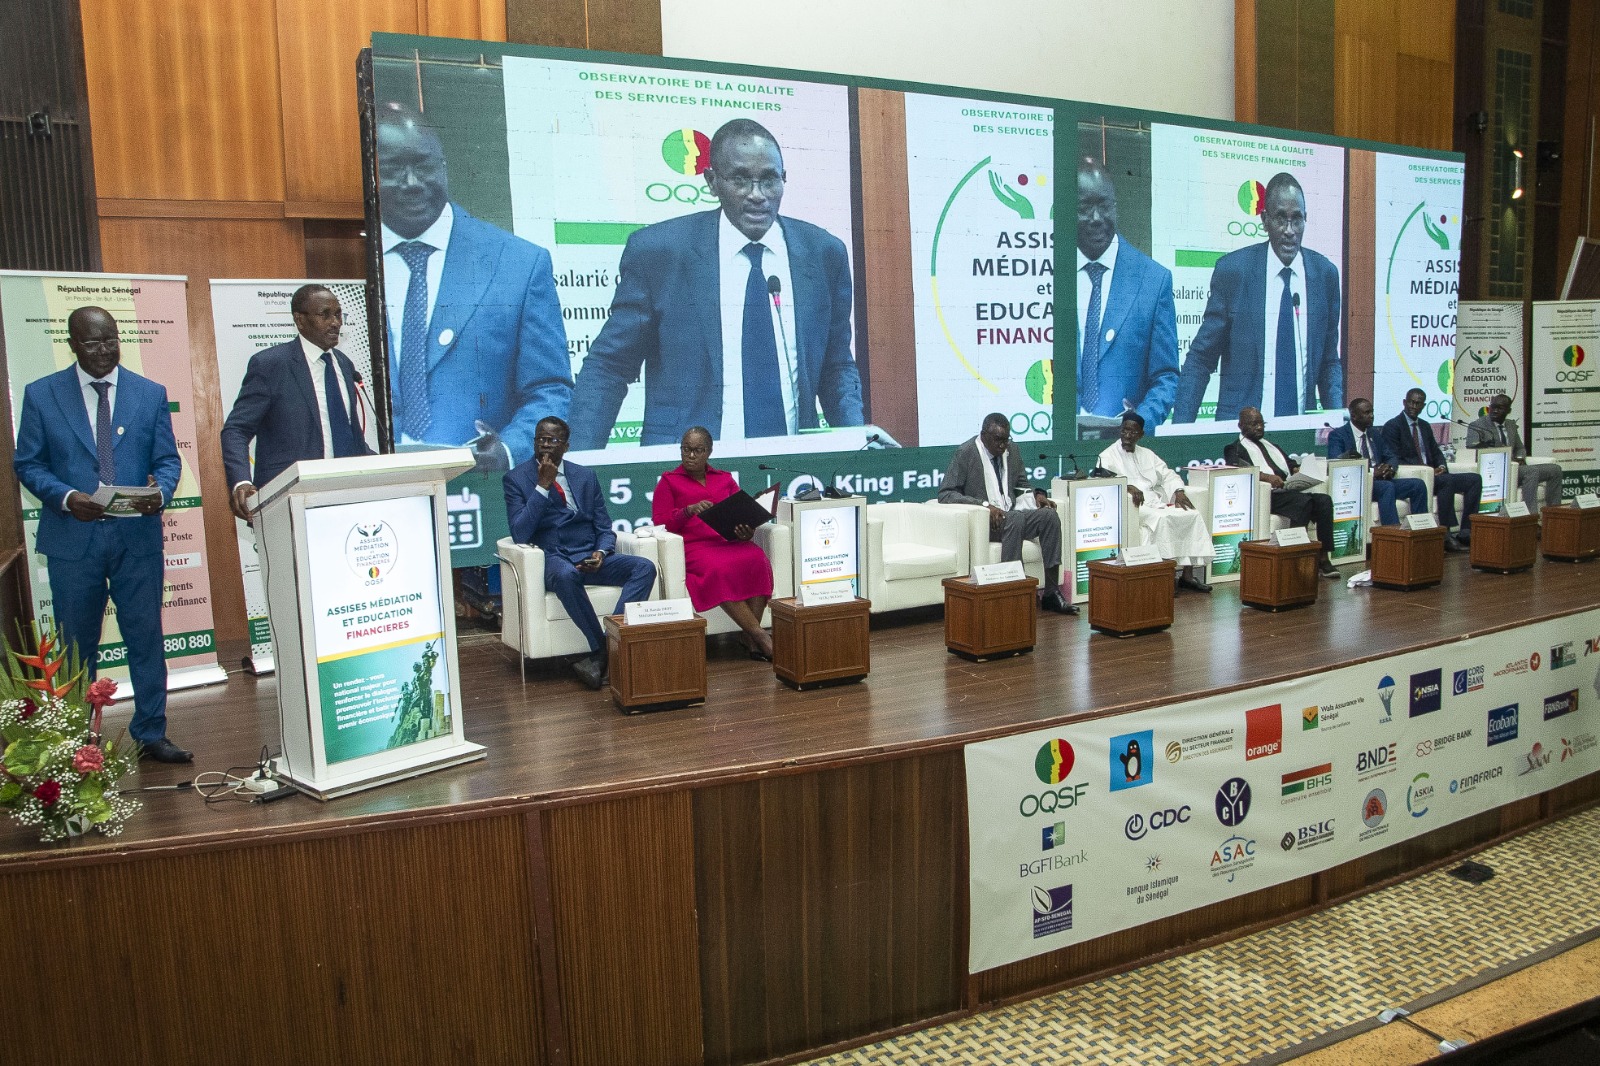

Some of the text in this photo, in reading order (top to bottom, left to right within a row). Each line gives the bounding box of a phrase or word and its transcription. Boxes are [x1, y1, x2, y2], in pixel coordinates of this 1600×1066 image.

[578, 71, 794, 97] OBSERVATOIRE DE LA QUALITE
[595, 90, 782, 112] DES SERVICES FINANCIERS
[961, 108, 1054, 122] OBSERVATOIRE D
[973, 124, 1049, 137] DES SERVICES
[1193, 135, 1314, 156] OBSERVATOIRE DE LA QUALITE
[1202, 150, 1307, 168] DES SERVICES FINANCIERS
[1408, 164, 1458, 174] OBSERVATOIRE
[1429, 178, 1461, 186] SERVICES
[645, 182, 722, 205] OQS
[1228, 221, 1269, 238] OQS
[997, 230, 1054, 250] ASSIS
[972, 254, 1054, 277] MÉDIA
[57, 285, 99, 295] République
[112, 286, 141, 295] Sénégal
[258, 291, 293, 299] République
[1037, 281, 1052, 296] et
[1410, 278, 1459, 295] MÉDIA
[976, 302, 1054, 321] EDUCA
[1448, 300, 1457, 309] et
[1411, 314, 1458, 329] EDUCA
[976, 327, 1054, 345] FINANC
[1410, 333, 1457, 348] FINANC
[1463, 374, 1507, 382] MÉDIATION
[1555, 370, 1595, 383] OQSF
[1463, 395, 1492, 403] FINANCI
[1464, 388, 1507, 396] EDUCATION
[1426, 400, 1452, 418] OQ
[1010, 411, 1051, 436] OQ
[835, 469, 946, 496] King Fah
[1562, 487, 1581, 496] 880
[29, 499, 190, 518] et avec
[167, 519, 178, 527] de
[171, 532, 193, 541] Poste
[327, 592, 422, 616] ASSISES MÉDIATION
[342, 607, 413, 627] ET EDUCATION
[346, 620, 410, 640] FINANCIERES
[164, 637, 186, 652] 880
[189, 634, 211, 649] 880
[1468, 664, 1485, 676] CORIS
[334, 679, 397, 697] national majeur pour
[344, 678, 365, 687] rendez
[369, 673, 385, 681] vous
[1421, 683, 1439, 694] NSIA
[1468, 675, 1484, 686] BANK
[335, 694, 364, 705] renforcer
[336, 700, 372, 715] promouvoir
[337, 721, 357, 730] avenir
[1488, 714, 1518, 733] Ecobank
[1433, 729, 1472, 747] BRIDGE BANK
[1247, 741, 1279, 757] orange
[1356, 742, 1397, 771] BNDE
[1306, 773, 1332, 790] BHS
[1460, 766, 1503, 789] FINAFRICA
[1020, 782, 1089, 817] OQSF
[1414, 785, 1434, 798] ASKIA
[1149, 805, 1191, 830] CDC
[1298, 818, 1335, 839] BSIC
[1210, 840, 1256, 866] ASAC
[1127, 875, 1179, 896] Banque Islamique
[1137, 887, 1169, 905] du Sénégal
